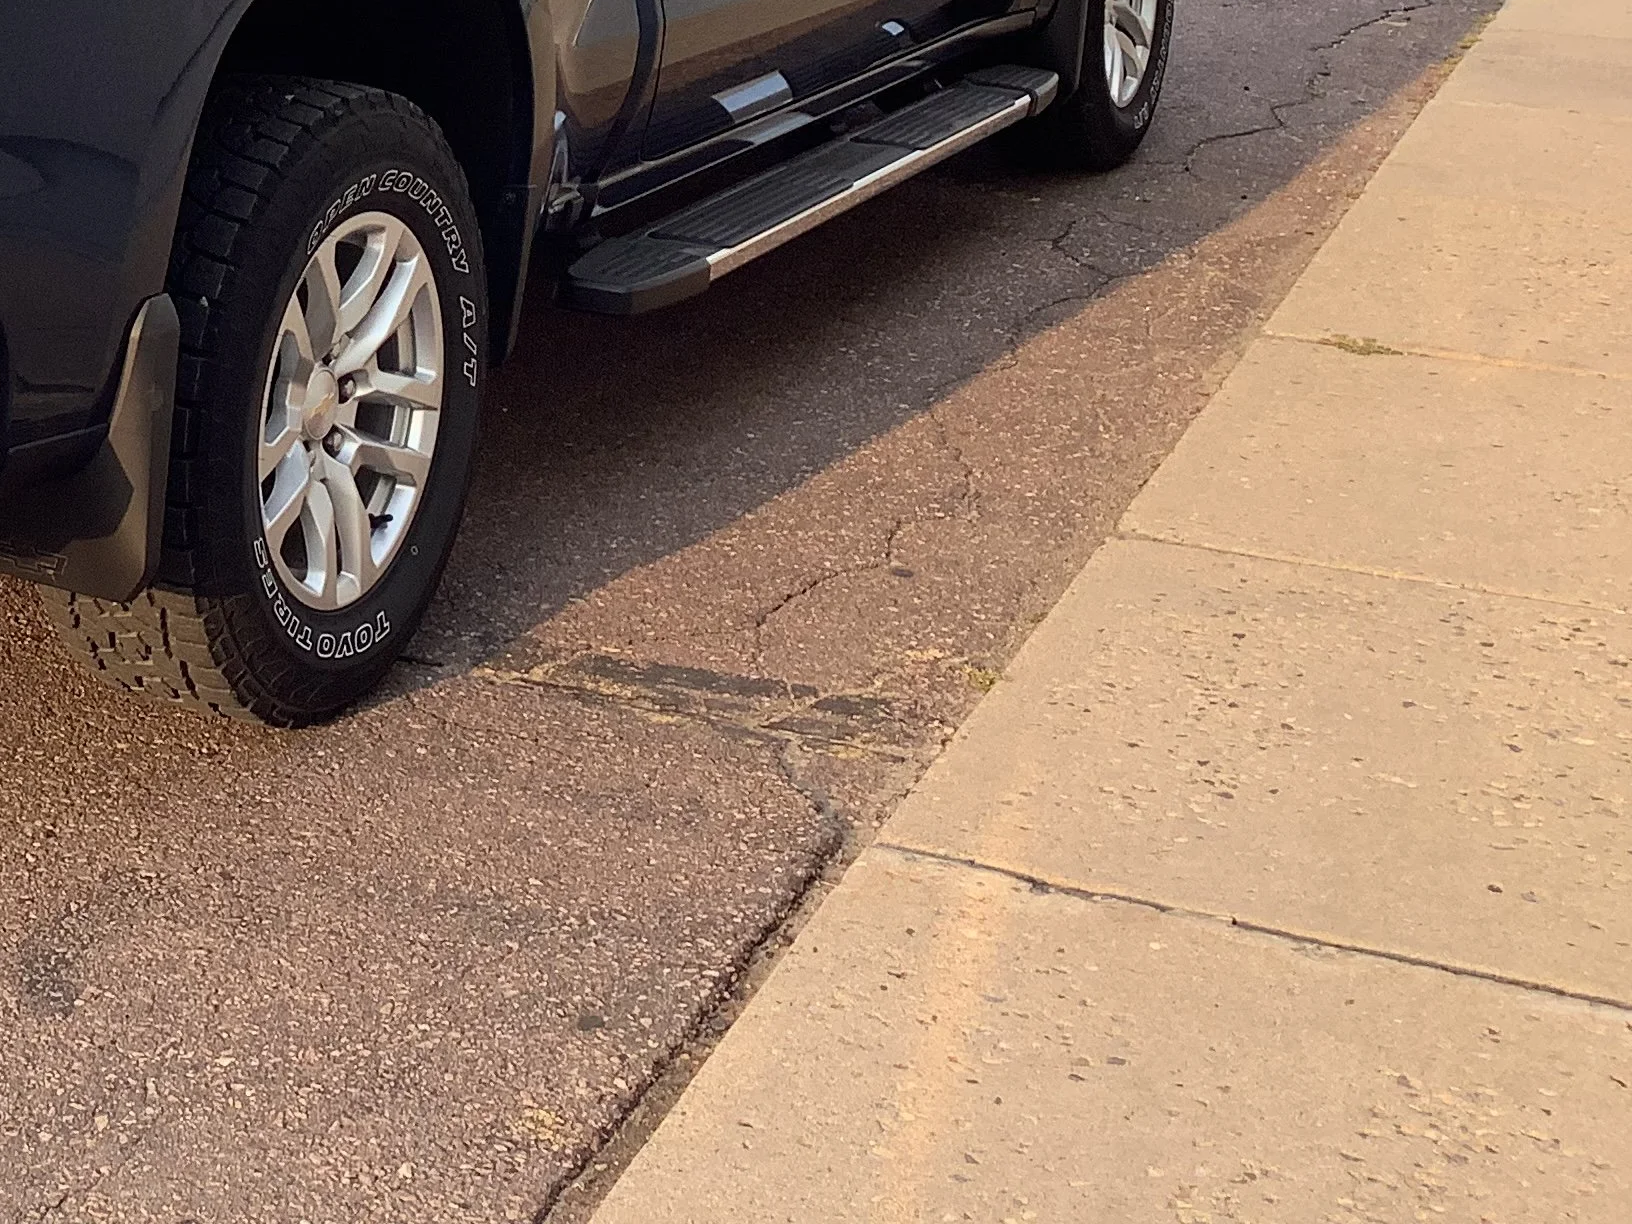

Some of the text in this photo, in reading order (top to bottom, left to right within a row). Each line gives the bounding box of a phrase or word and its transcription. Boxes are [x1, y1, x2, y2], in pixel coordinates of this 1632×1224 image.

[307, 170, 477, 386] OPEN COUNTRY A/T
[254, 538, 390, 658] TOYO TIRES
